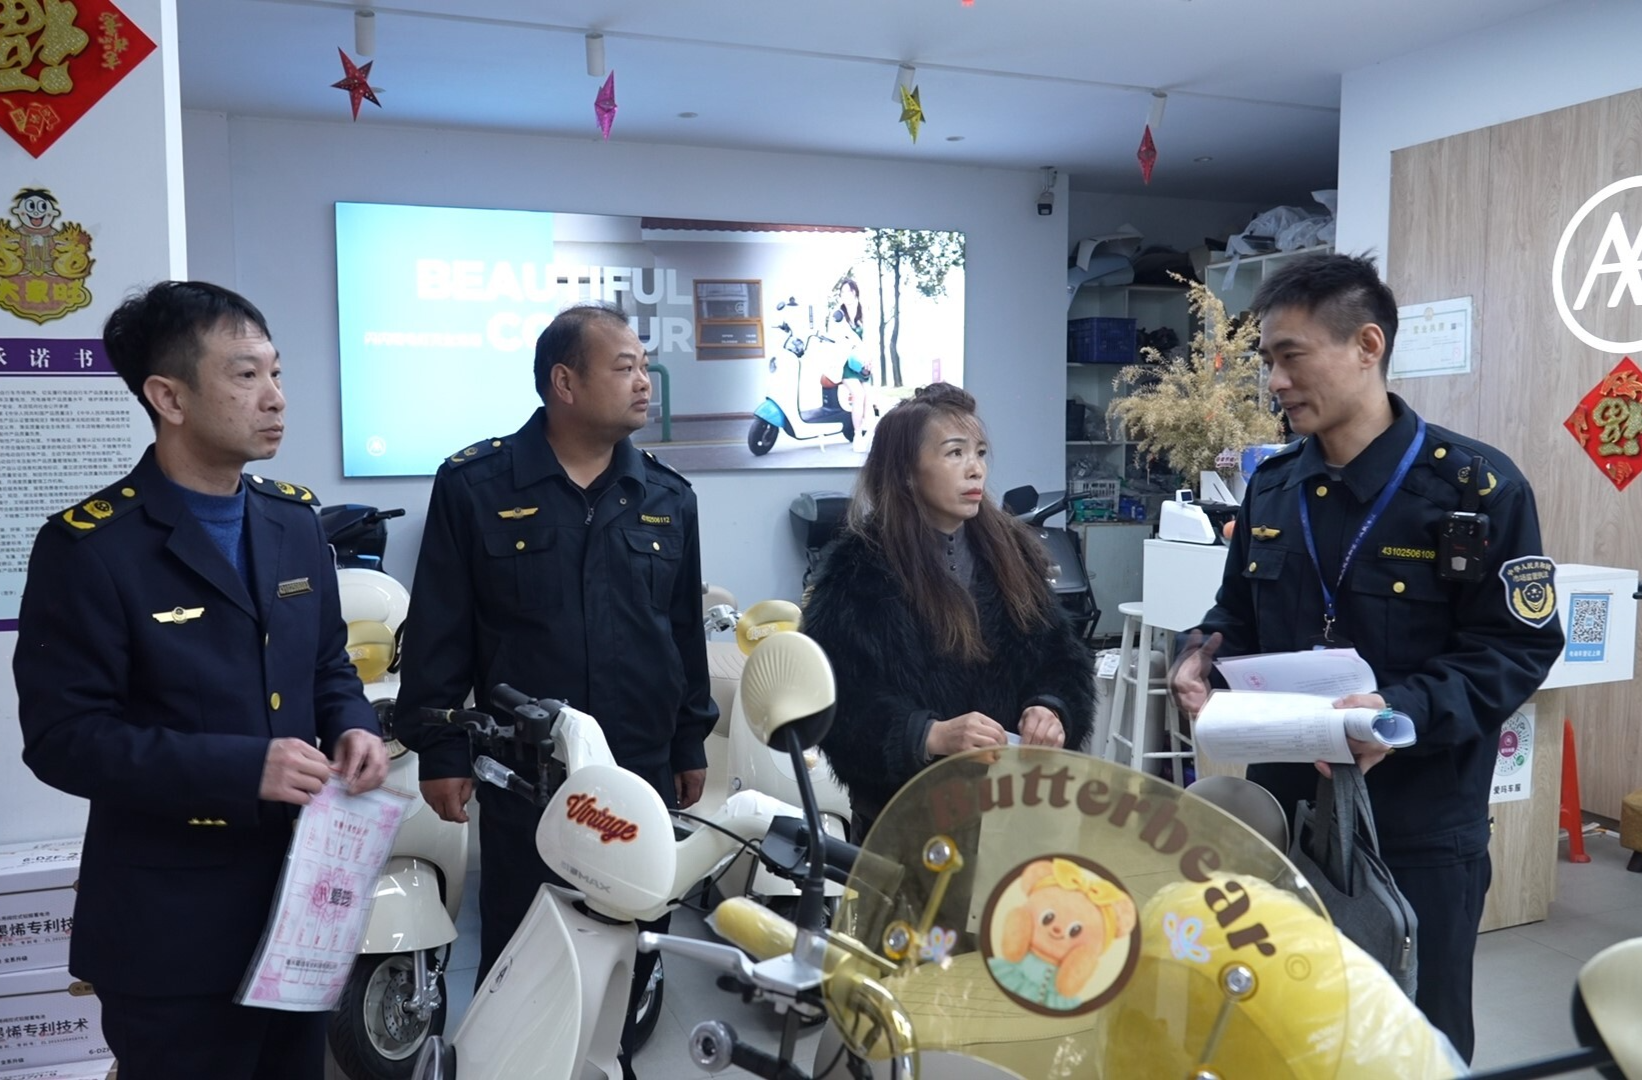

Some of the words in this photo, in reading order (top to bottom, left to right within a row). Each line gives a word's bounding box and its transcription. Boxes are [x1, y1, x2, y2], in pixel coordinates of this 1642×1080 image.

[416, 258, 693, 306] BEAUTIFUL
[1381, 546, 1436, 559] 43102506109
[1506, 561, 1552, 576] 中华人民共和国
[566, 793, 638, 844] Vintage
[930, 764, 1277, 957] Butterbear
